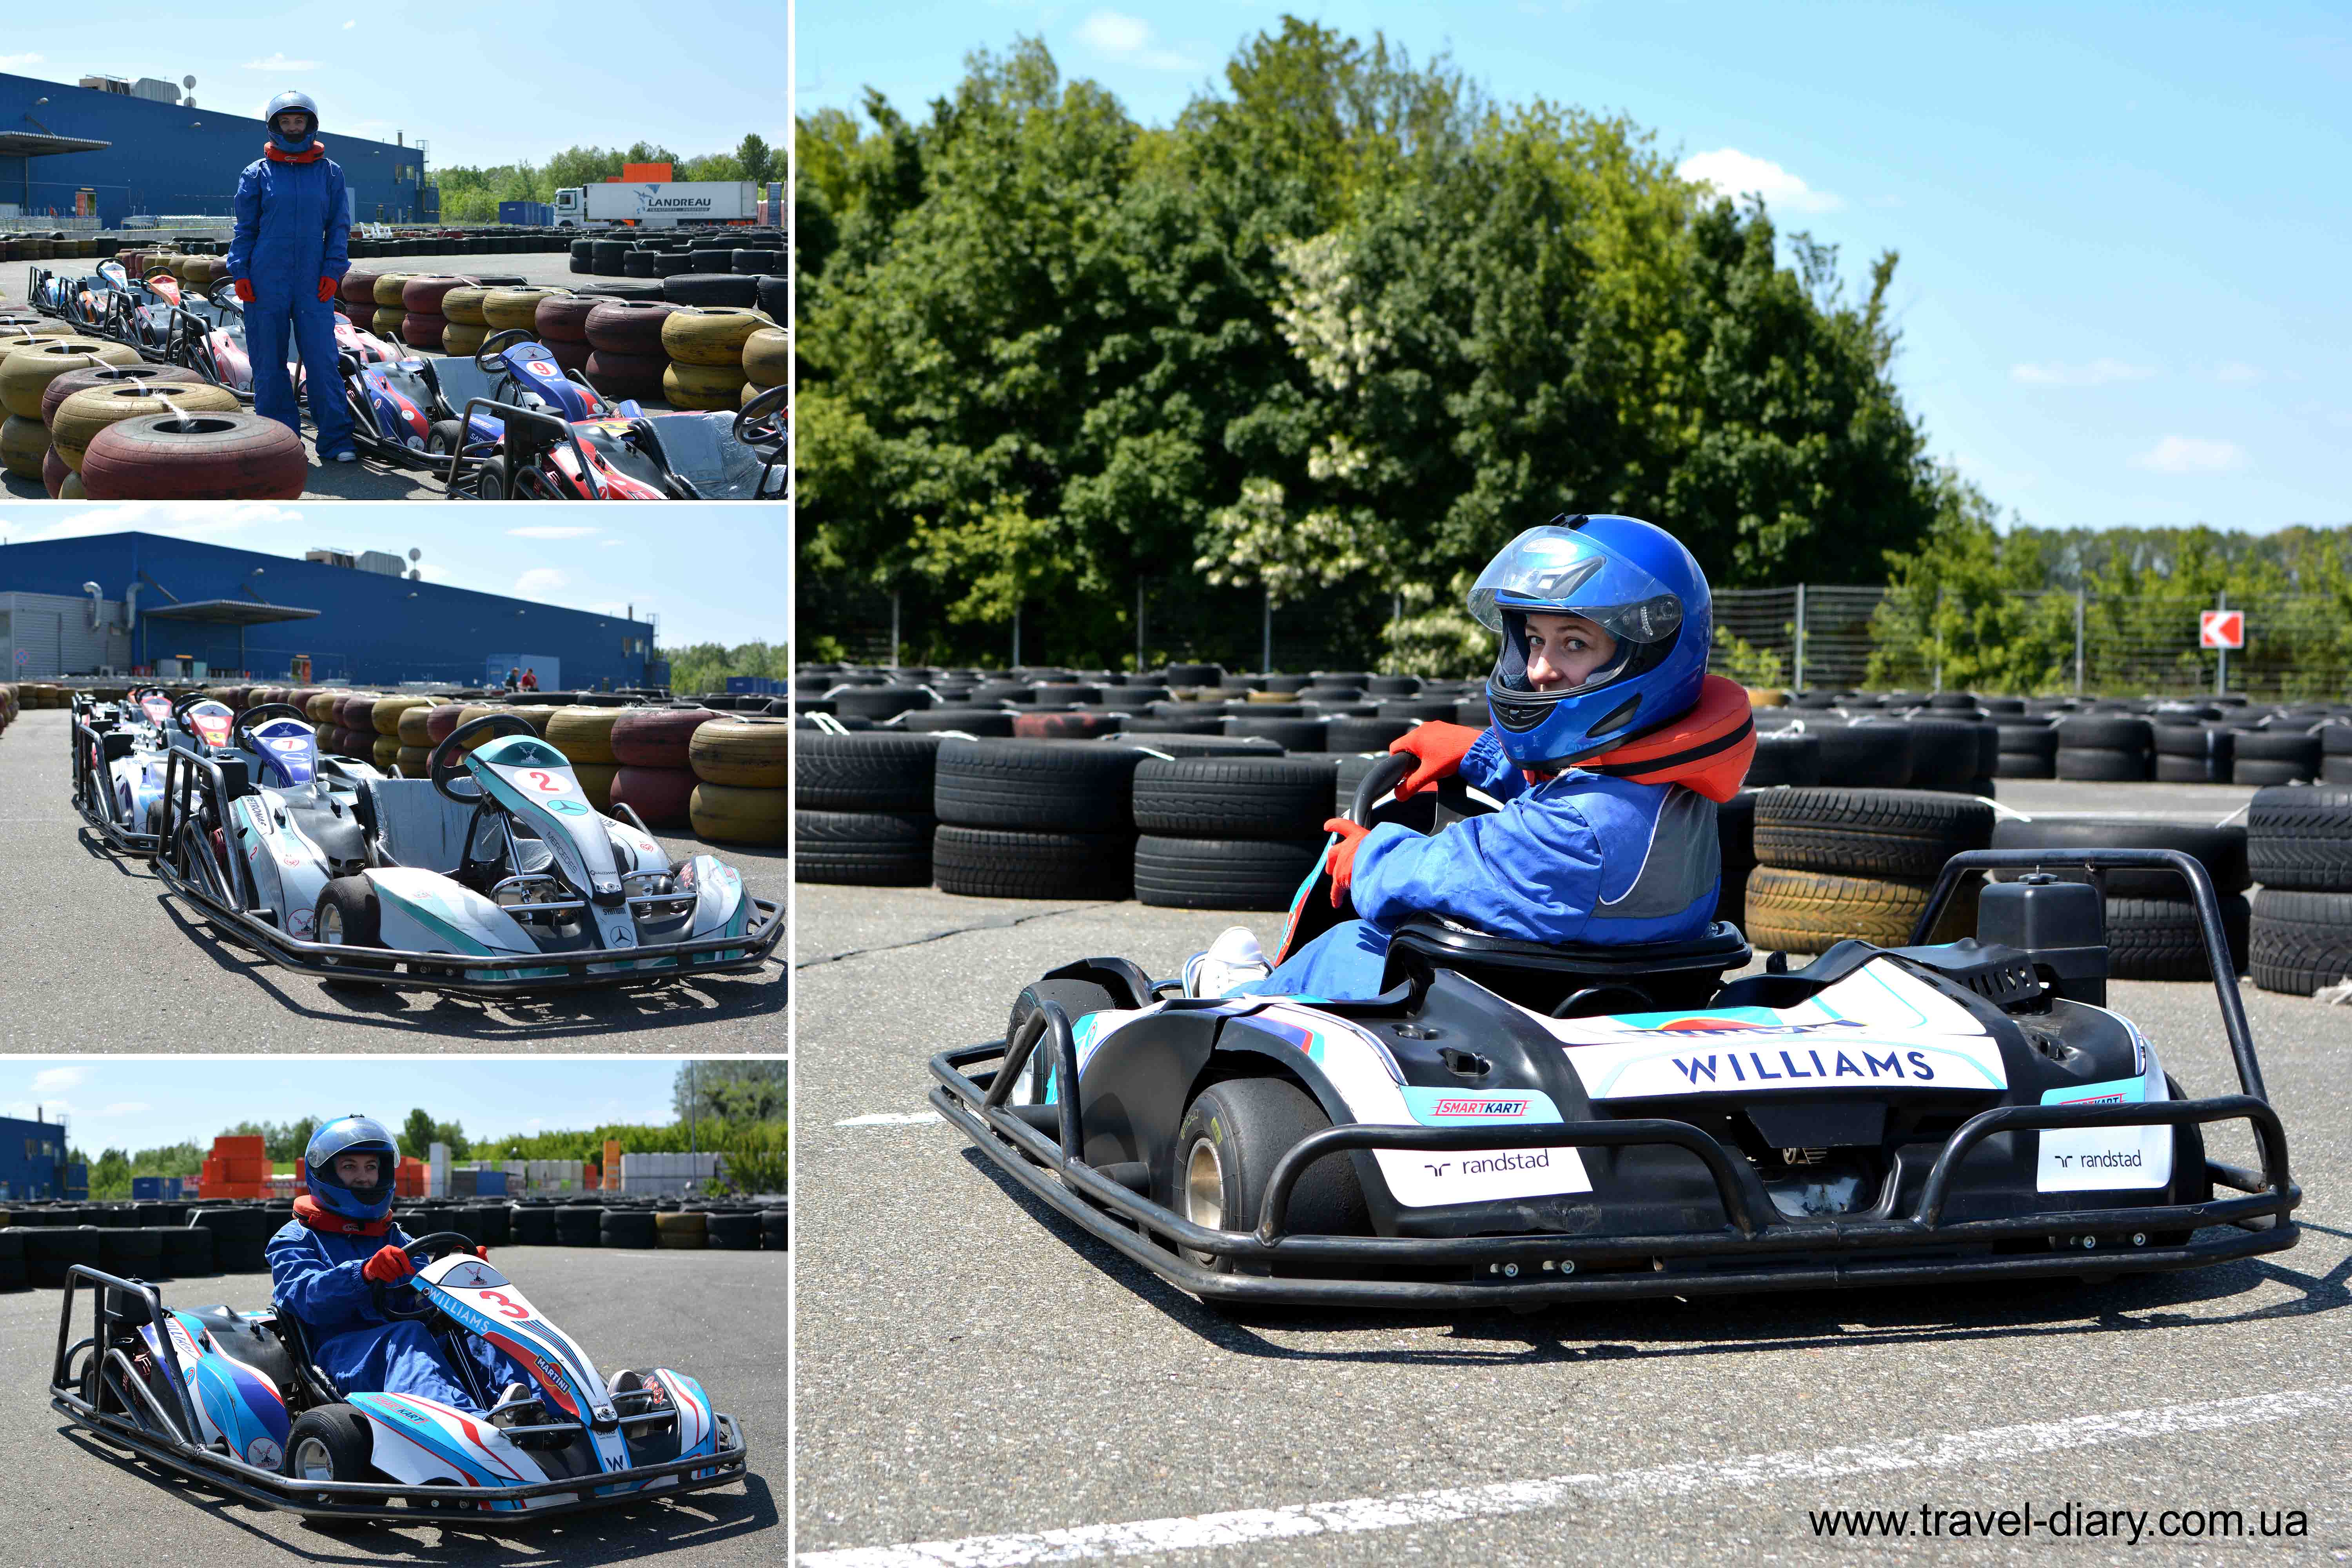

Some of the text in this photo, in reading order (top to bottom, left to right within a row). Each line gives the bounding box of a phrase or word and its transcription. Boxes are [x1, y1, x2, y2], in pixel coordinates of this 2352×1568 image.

[533, 363, 551, 375] 9
[375, 399, 380, 408] 9
[282, 740, 293, 749] 7
[530, 772, 559, 791] 2
[250, 846, 258, 860] 2
[546, 831, 577, 874] MERCEDES
[603, 907, 626, 916] SYNTIUM
[1673, 1051, 1934, 1085] WILLIAMS
[1445, 1103, 1522, 1113] SMARTKART
[1463, 1149, 1549, 1174] randstad
[2081, 1150, 2141, 1167] randstad
[429, 1288, 490, 1332] WILLIAMS
[479, 1291, 529, 1318] 3
[537, 1358, 568, 1392] MARTINI
[375, 1396, 425, 1421] SMARTKART
